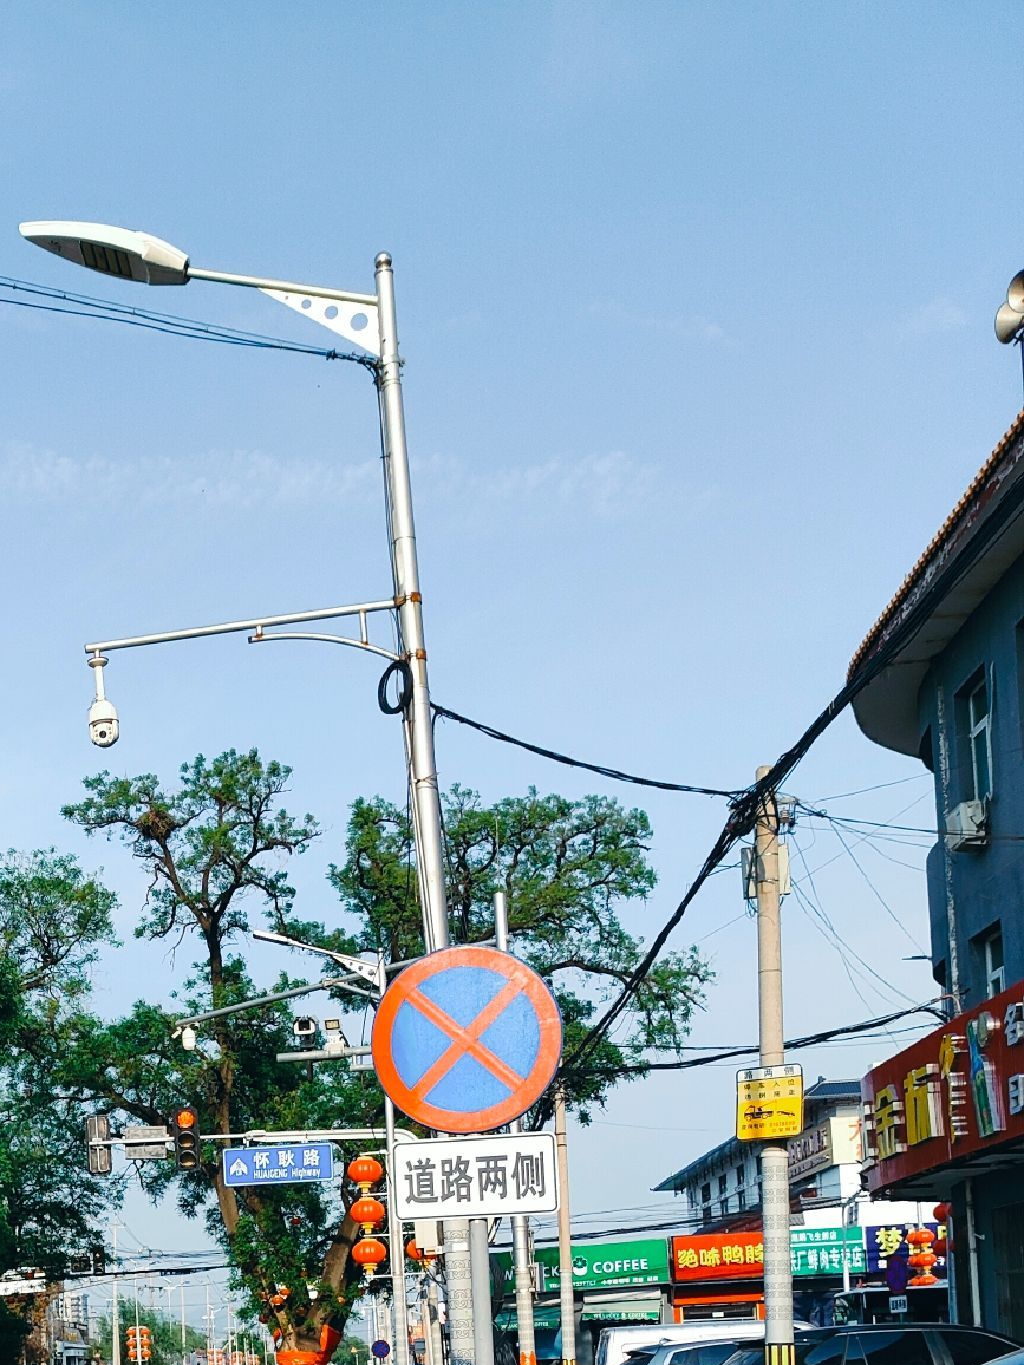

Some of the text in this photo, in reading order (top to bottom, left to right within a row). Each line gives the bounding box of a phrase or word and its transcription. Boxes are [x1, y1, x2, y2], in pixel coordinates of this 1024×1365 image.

[253, 1148, 320, 1169] 怀耿路
[404, 1151, 546, 1204] 道路两侧
[593, 1258, 648, 1274] COFFEE
